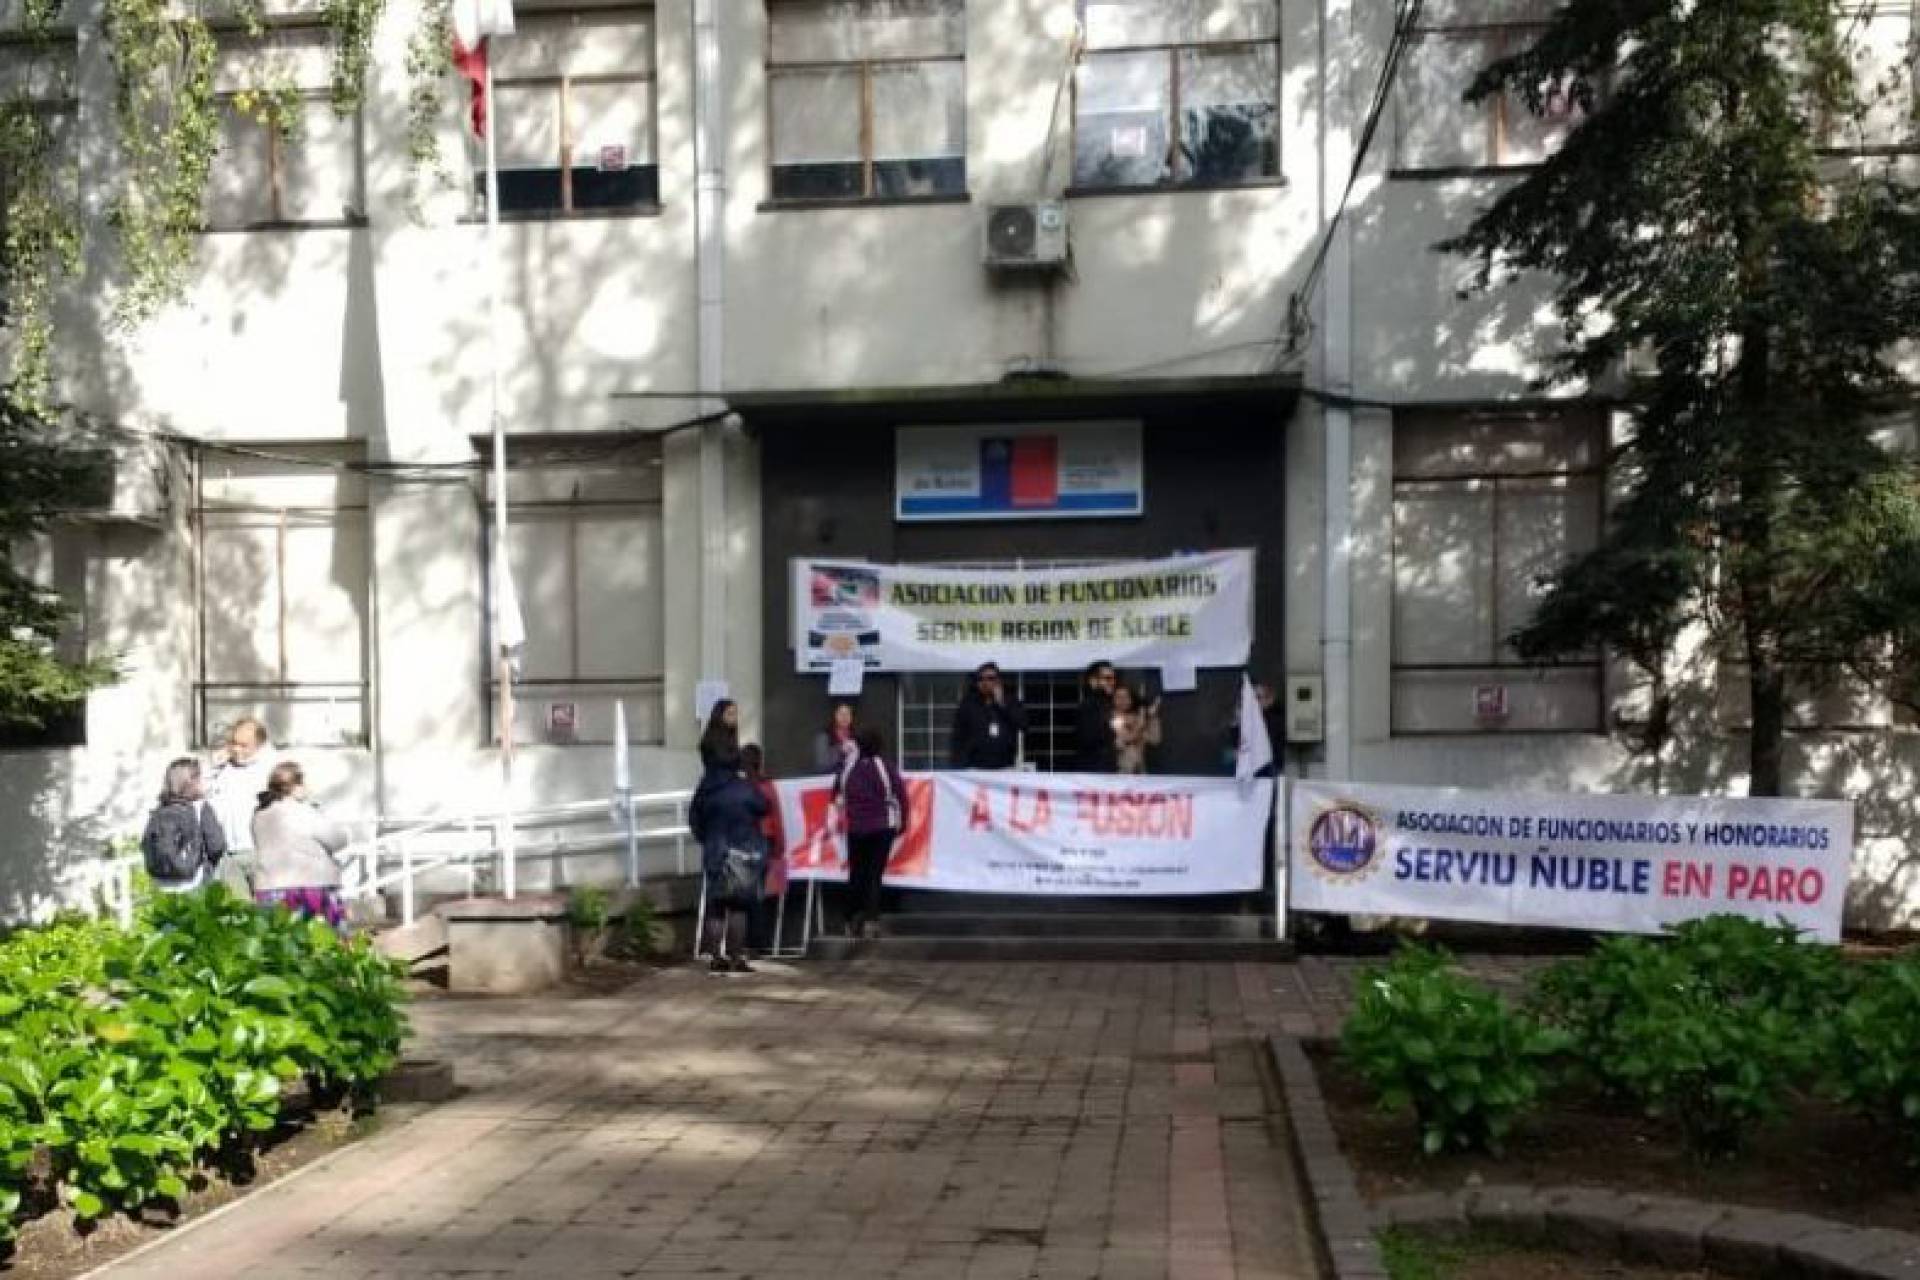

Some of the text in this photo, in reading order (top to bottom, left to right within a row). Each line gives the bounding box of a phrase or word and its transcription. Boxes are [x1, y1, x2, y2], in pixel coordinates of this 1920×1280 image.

[892, 573, 1217, 605] ASOCIACION DE FUNCIONARIOS
[969, 784, 994, 832] A
[1508, 817, 1533, 839] DE
[1538, 818, 1682, 844] FUNCIONARIOS
[1686, 823, 1699, 844] Y
[1704, 822, 1830, 850] HONORARIOS
[1394, 847, 1824, 905] SERVIU ÑUBLE EN PARO
